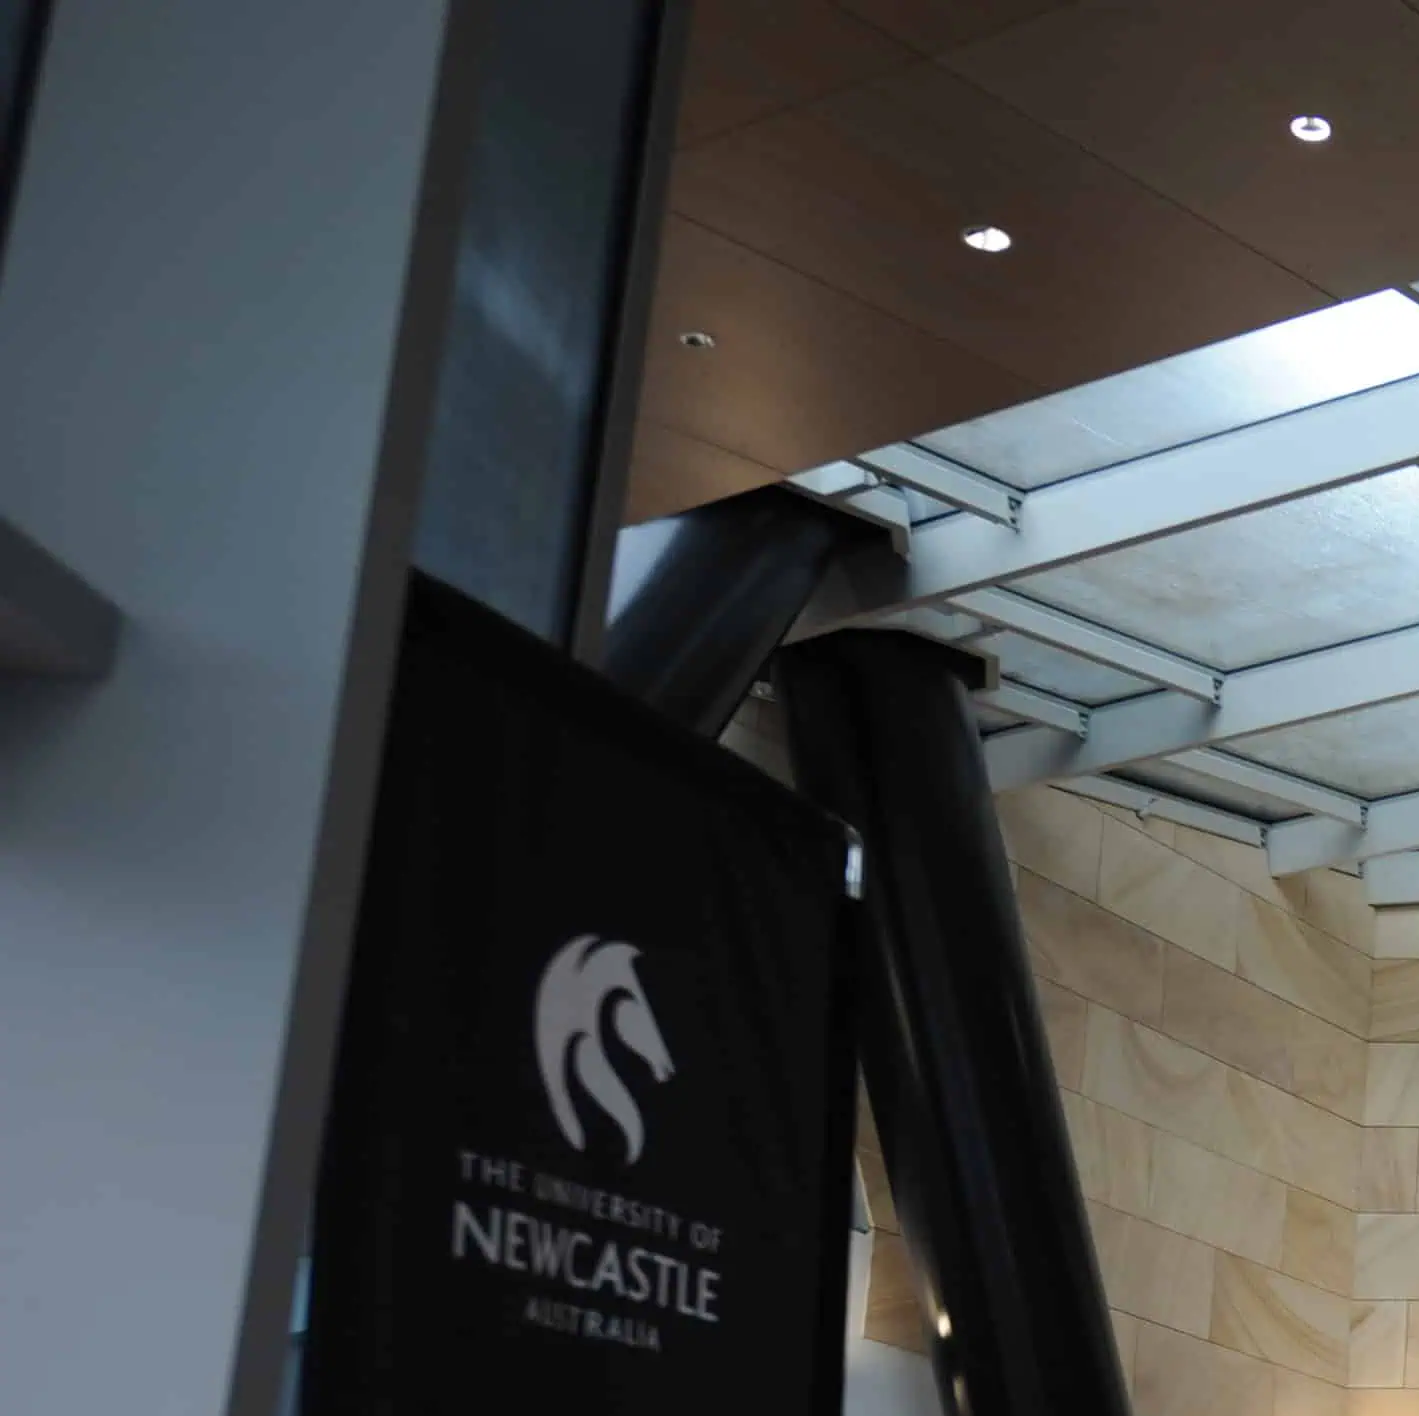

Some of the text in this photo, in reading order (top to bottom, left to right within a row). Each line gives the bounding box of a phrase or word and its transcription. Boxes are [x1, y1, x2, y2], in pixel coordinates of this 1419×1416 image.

[458, 1150, 725, 1253] THE UNIVERSITY OF
[452, 1199, 721, 1322] NEWCASTLE
[523, 1295, 661, 1351] AUSTRALIA
